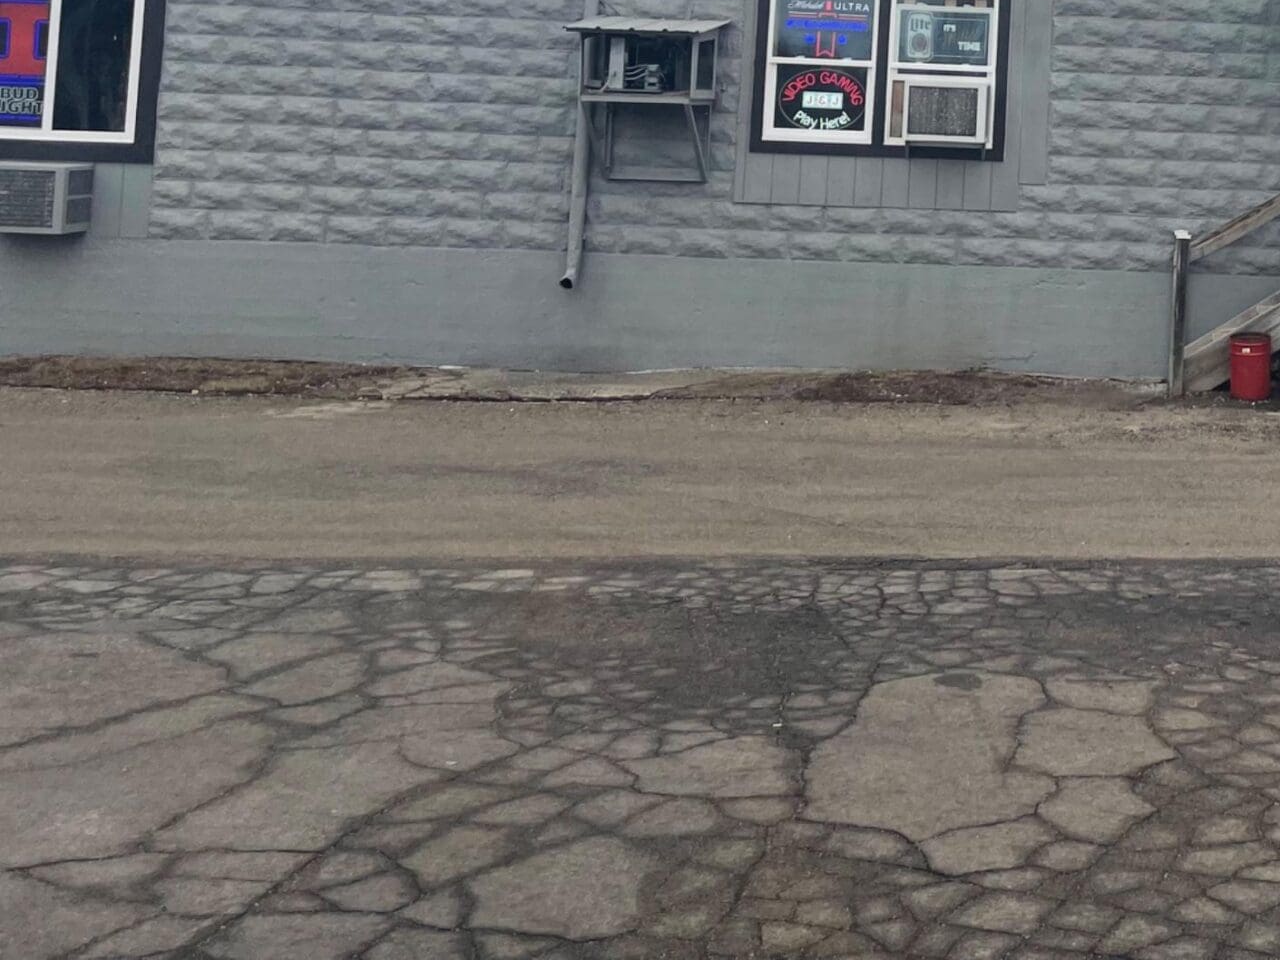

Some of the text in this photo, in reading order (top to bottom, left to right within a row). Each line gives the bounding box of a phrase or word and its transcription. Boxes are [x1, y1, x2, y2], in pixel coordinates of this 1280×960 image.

[833, 2, 870, 12] ULTRA
[0, 86, 39, 100] BUD
[782, 71, 864, 106] VIDEO GAMING
[0, 100, 44, 114] IGHT
[793, 110, 818, 130] Play
